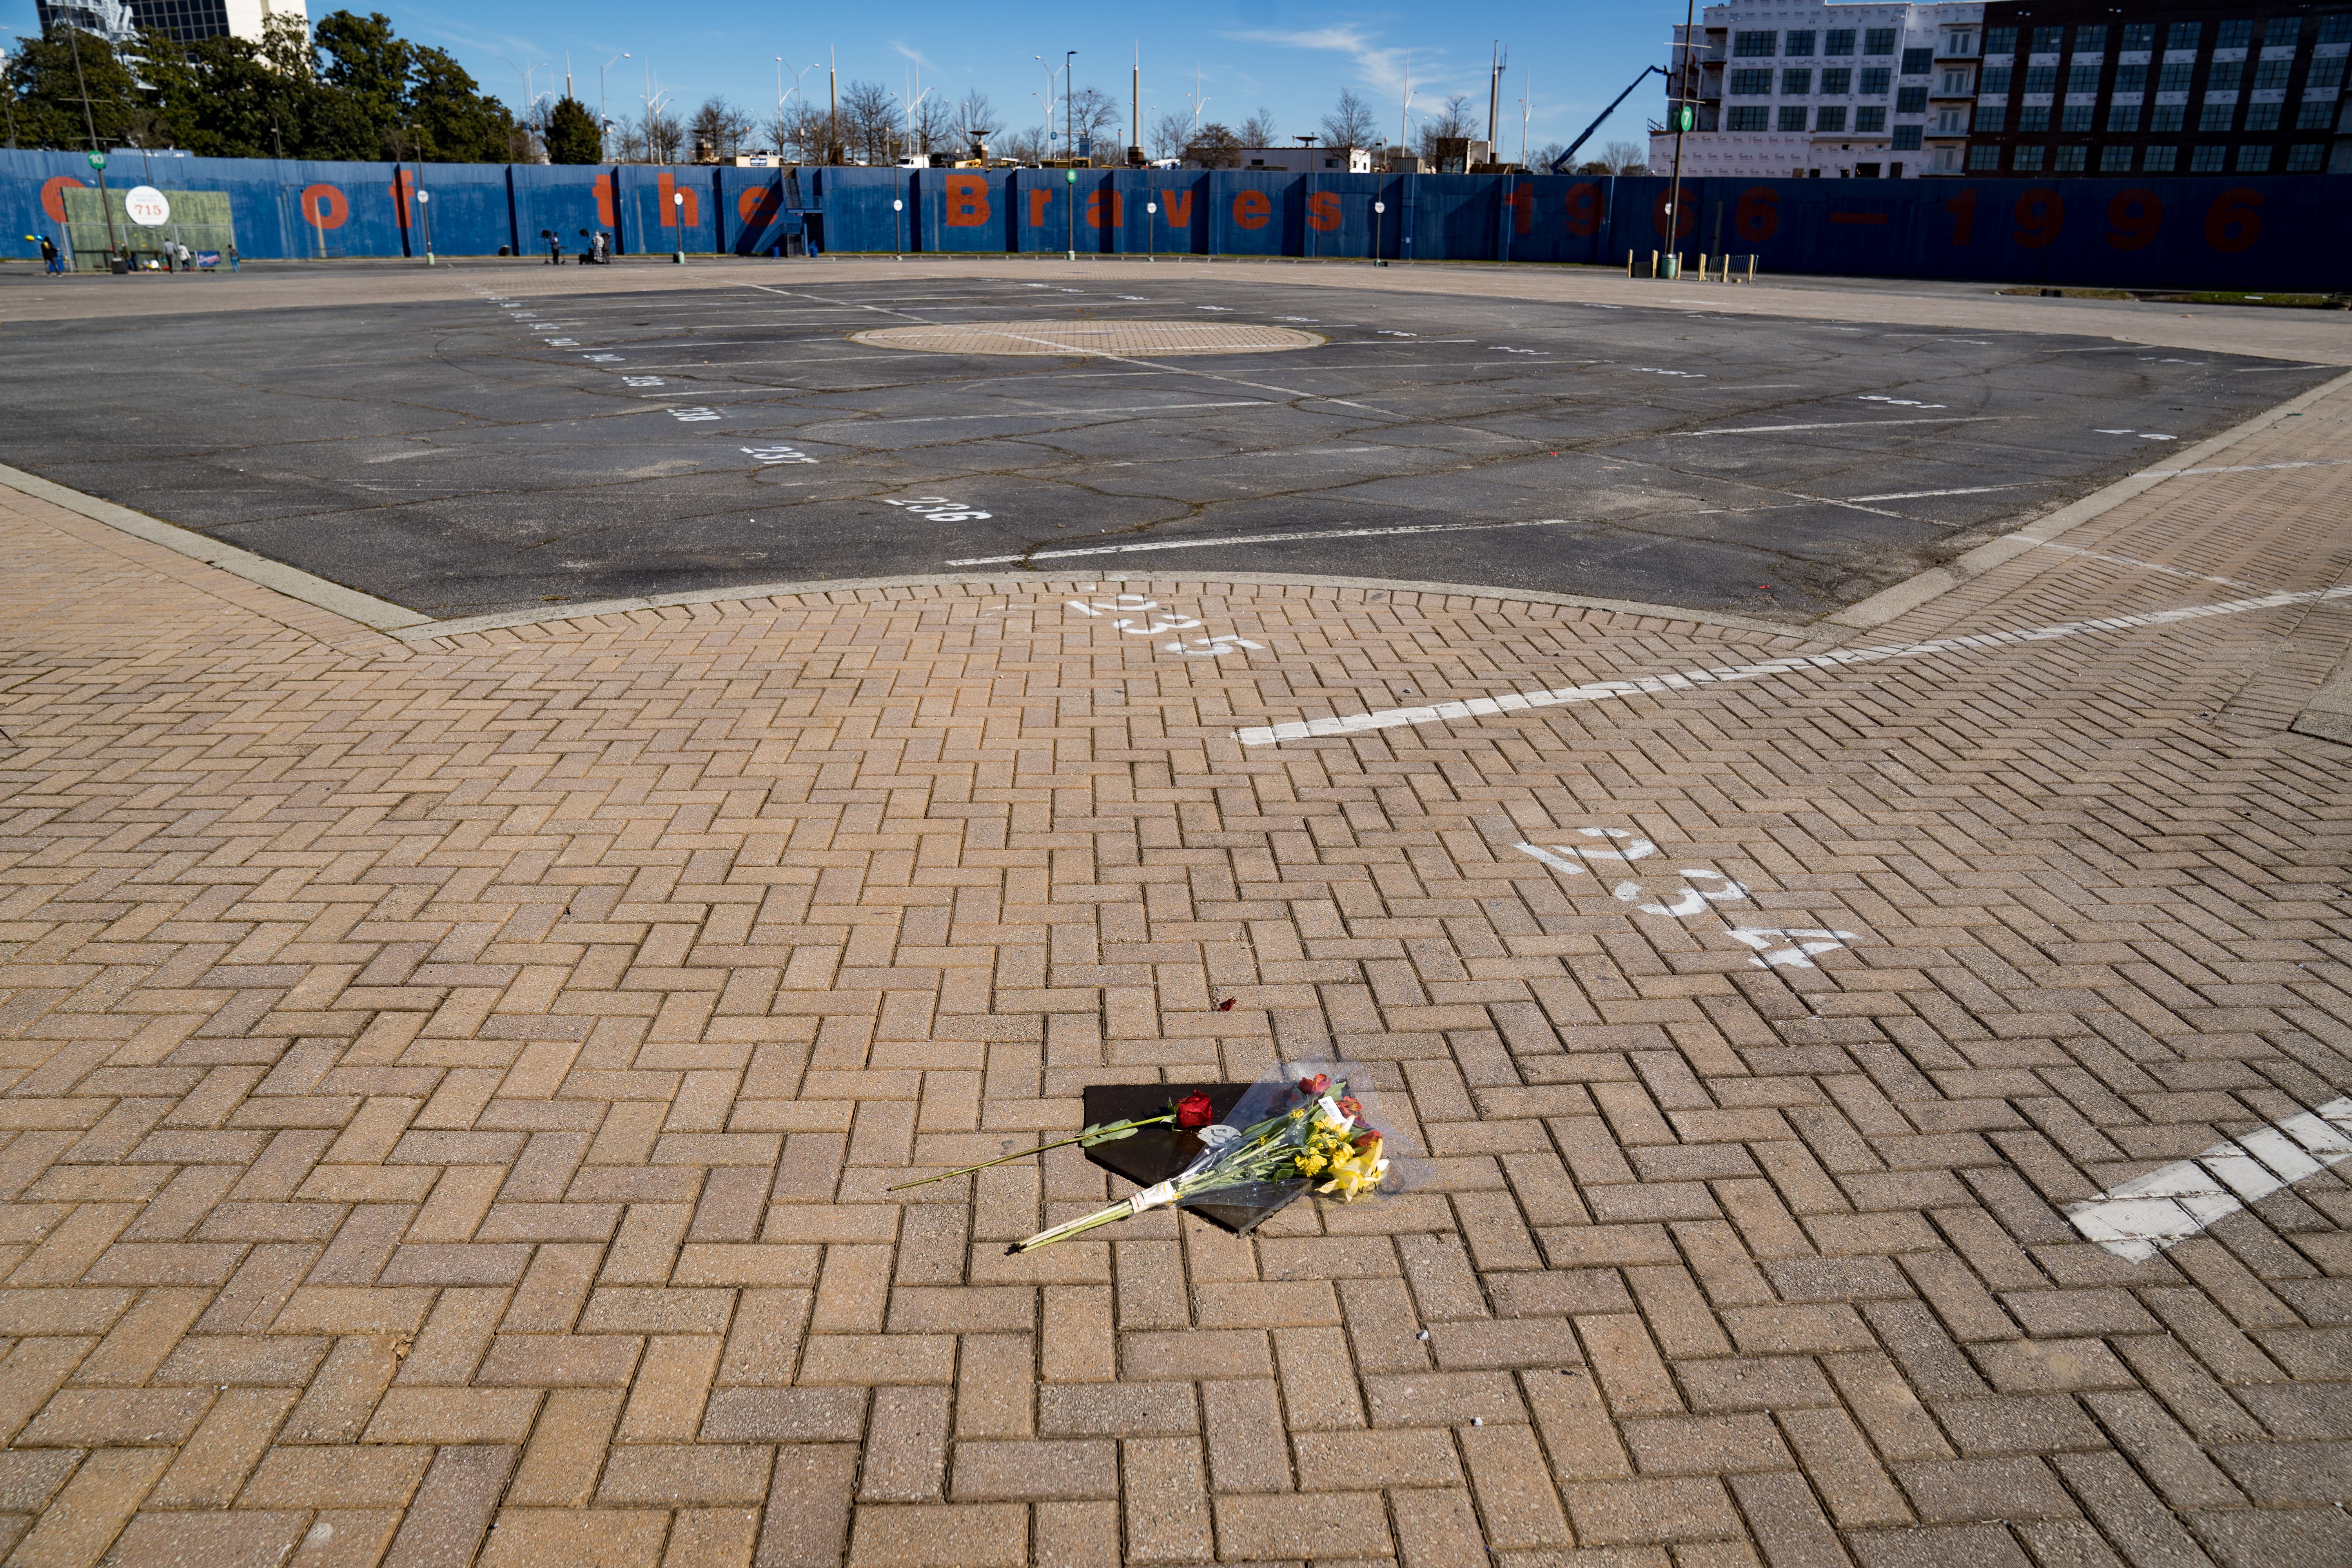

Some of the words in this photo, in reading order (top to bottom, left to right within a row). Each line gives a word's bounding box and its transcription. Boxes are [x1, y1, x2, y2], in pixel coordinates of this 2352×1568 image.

[1673, 112, 1679, 126] 7
[1684, 111, 1691, 126] 7
[89, 154, 104, 164] 10
[1069, 172, 1075, 180] 8
[135, 204, 161, 215] 715
[301, 170, 414, 229] of
[592, 173, 778, 227] the
[946, 174, 1342, 231] Braves
[1504, 182, 1779, 241] 1966
[1945, 188, 2265, 253] 1996
[583, 354, 626, 362] 240
[622, 375, 666, 387] 239
[1857, 395, 1948, 409] 196
[667, 407, 722, 421] 238
[740, 446, 820, 464] 237
[884, 496, 992, 522] 236
[1066, 594, 1266, 656] 235
[1513, 827, 1863, 969] 234
